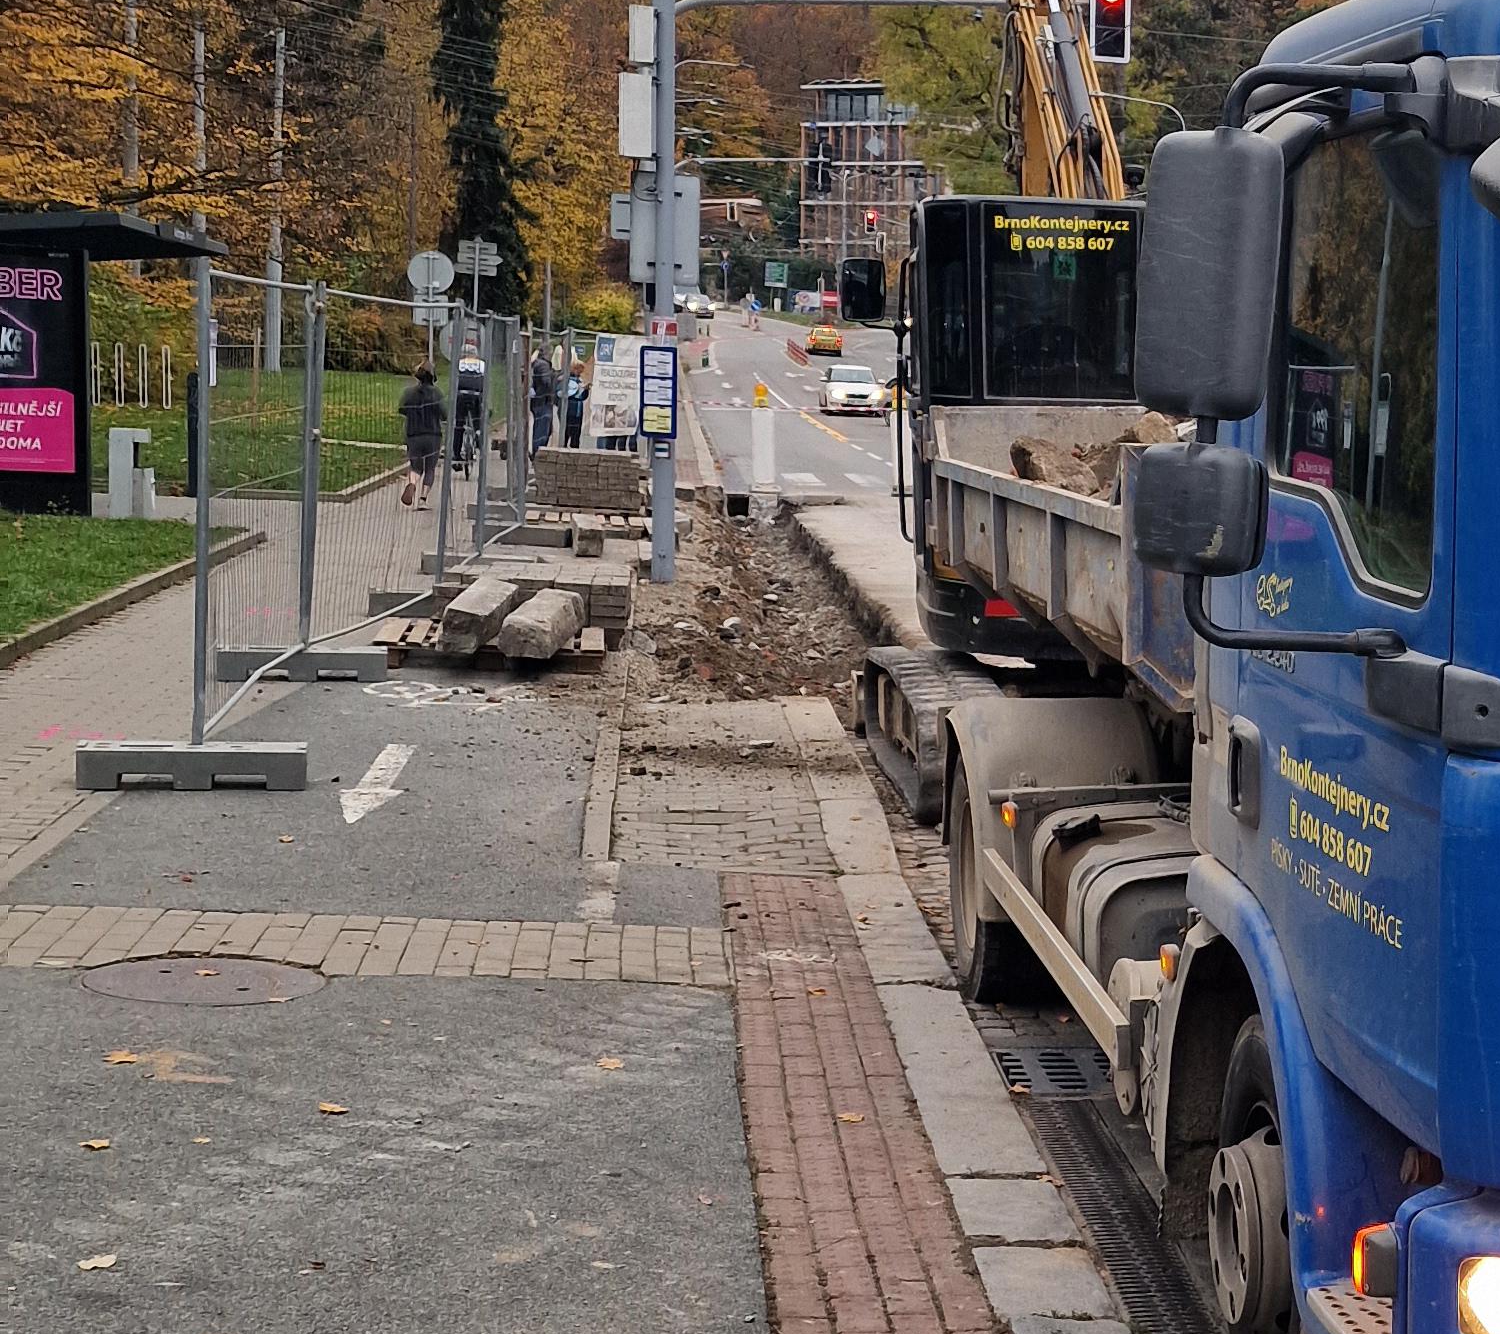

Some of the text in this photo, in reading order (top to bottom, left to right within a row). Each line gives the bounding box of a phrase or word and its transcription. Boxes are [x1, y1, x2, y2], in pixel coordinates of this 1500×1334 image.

[993, 215, 1130, 233] BrnoKontejnery.cz
[1026, 236, 1115, 250] 604 858 607
[1279, 744, 1391, 833] BrnoKontejnery.cz
[1300, 810, 1372, 877] 604 858 607
[1327, 877, 1362, 924] ZEMNÍ
[1363, 900, 1403, 949] PRÁCE
